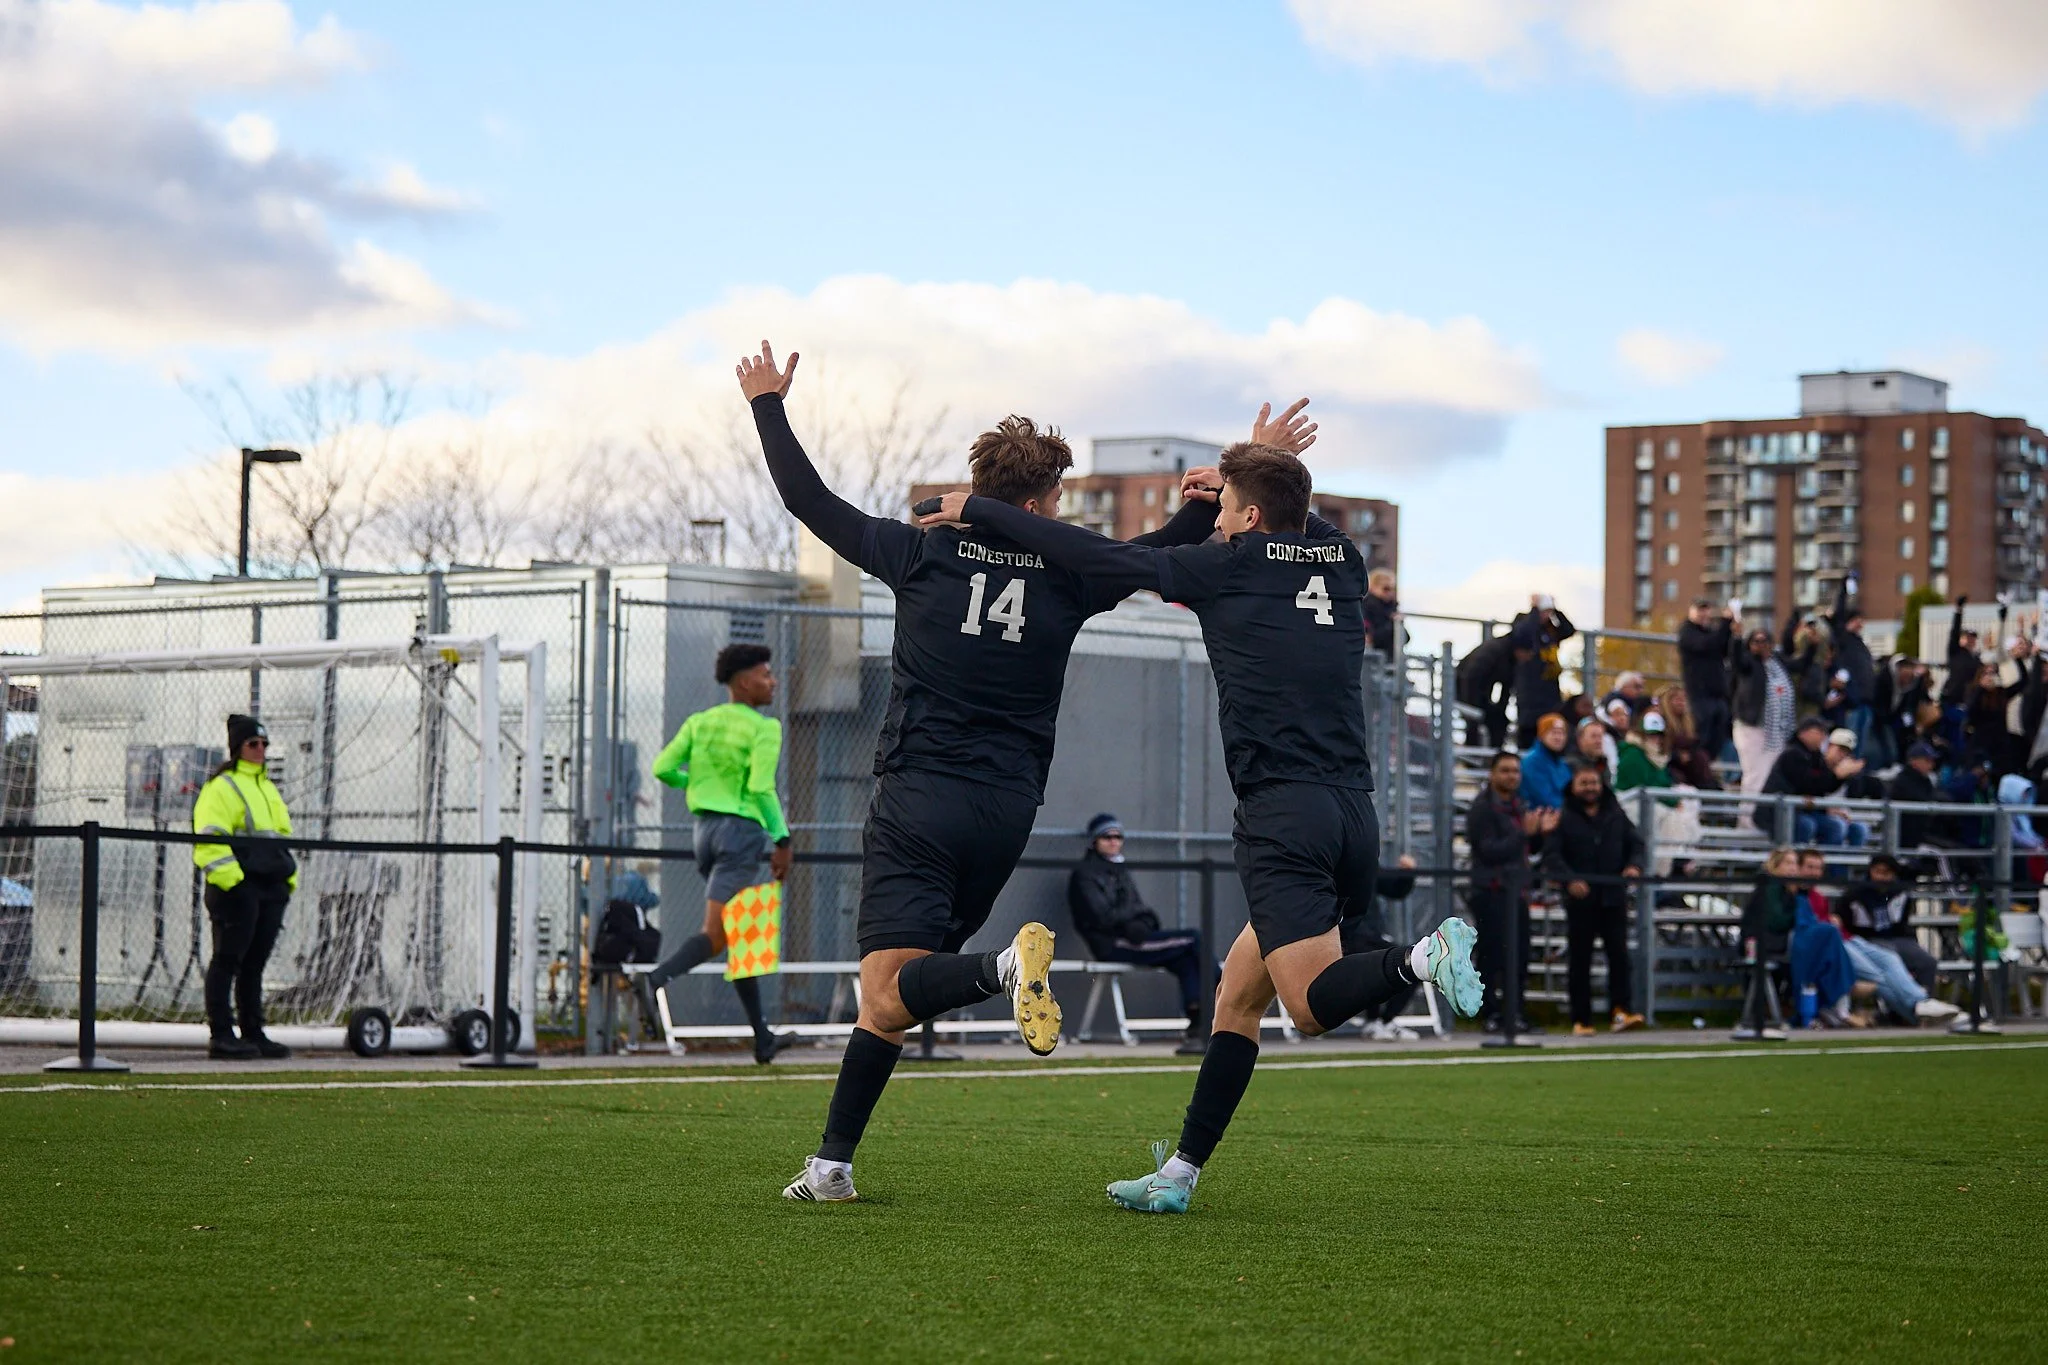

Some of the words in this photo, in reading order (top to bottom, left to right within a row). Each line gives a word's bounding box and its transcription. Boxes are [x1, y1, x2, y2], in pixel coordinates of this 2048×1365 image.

[957, 540, 1045, 569] CONESTOGA
[1266, 542, 1346, 563] CONESTOGA
[960, 572, 1026, 643] 14
[1295, 575, 1335, 626] 4
